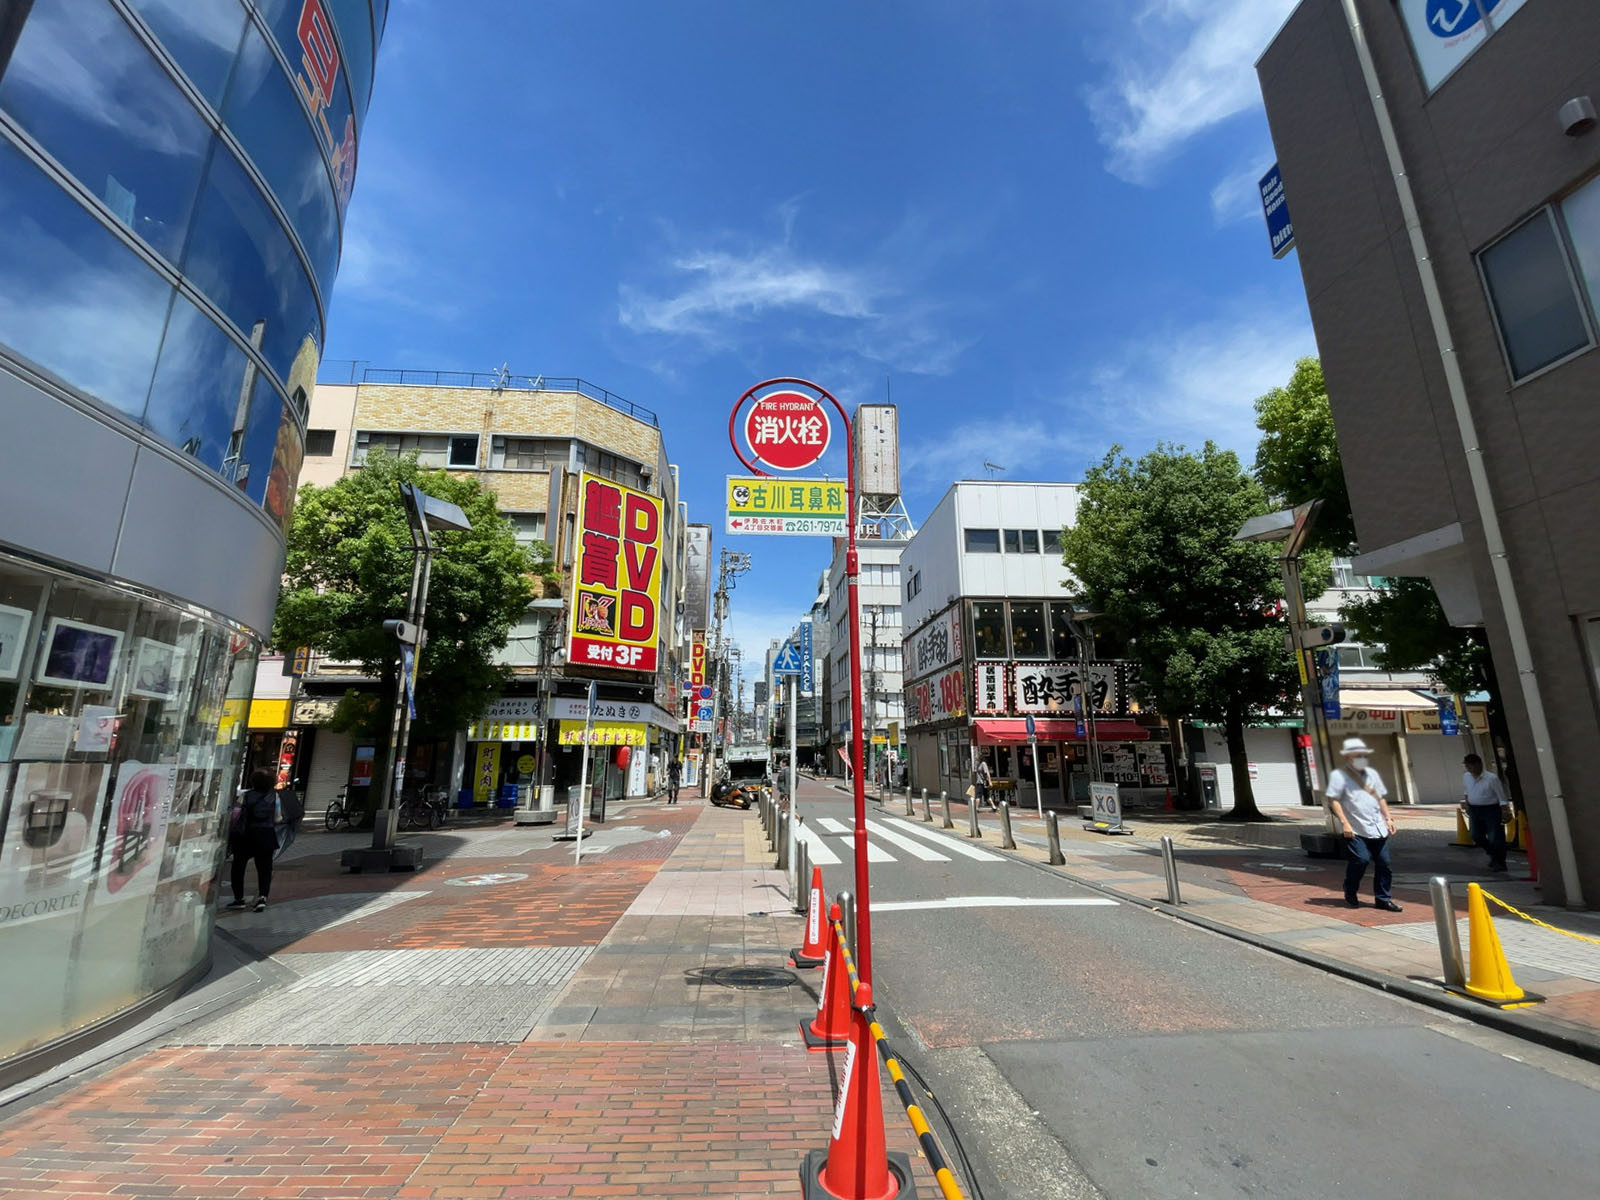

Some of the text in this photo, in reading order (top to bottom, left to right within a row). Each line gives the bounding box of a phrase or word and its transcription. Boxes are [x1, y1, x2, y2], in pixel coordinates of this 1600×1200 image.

[760, 402, 815, 411] FIRE HYDRANT
[754, 415, 823, 445] 消火栓
[752, 485, 842, 511] 古川耳鼻科
[581, 479, 622, 591] 鑑賞
[619, 491, 659, 642] DVD
[587, 643, 644, 666] 受付 3F
[693, 643, 704, 687] DVD
[939, 670, 962, 713] 180
[593, 705, 626, 718] たぬき
